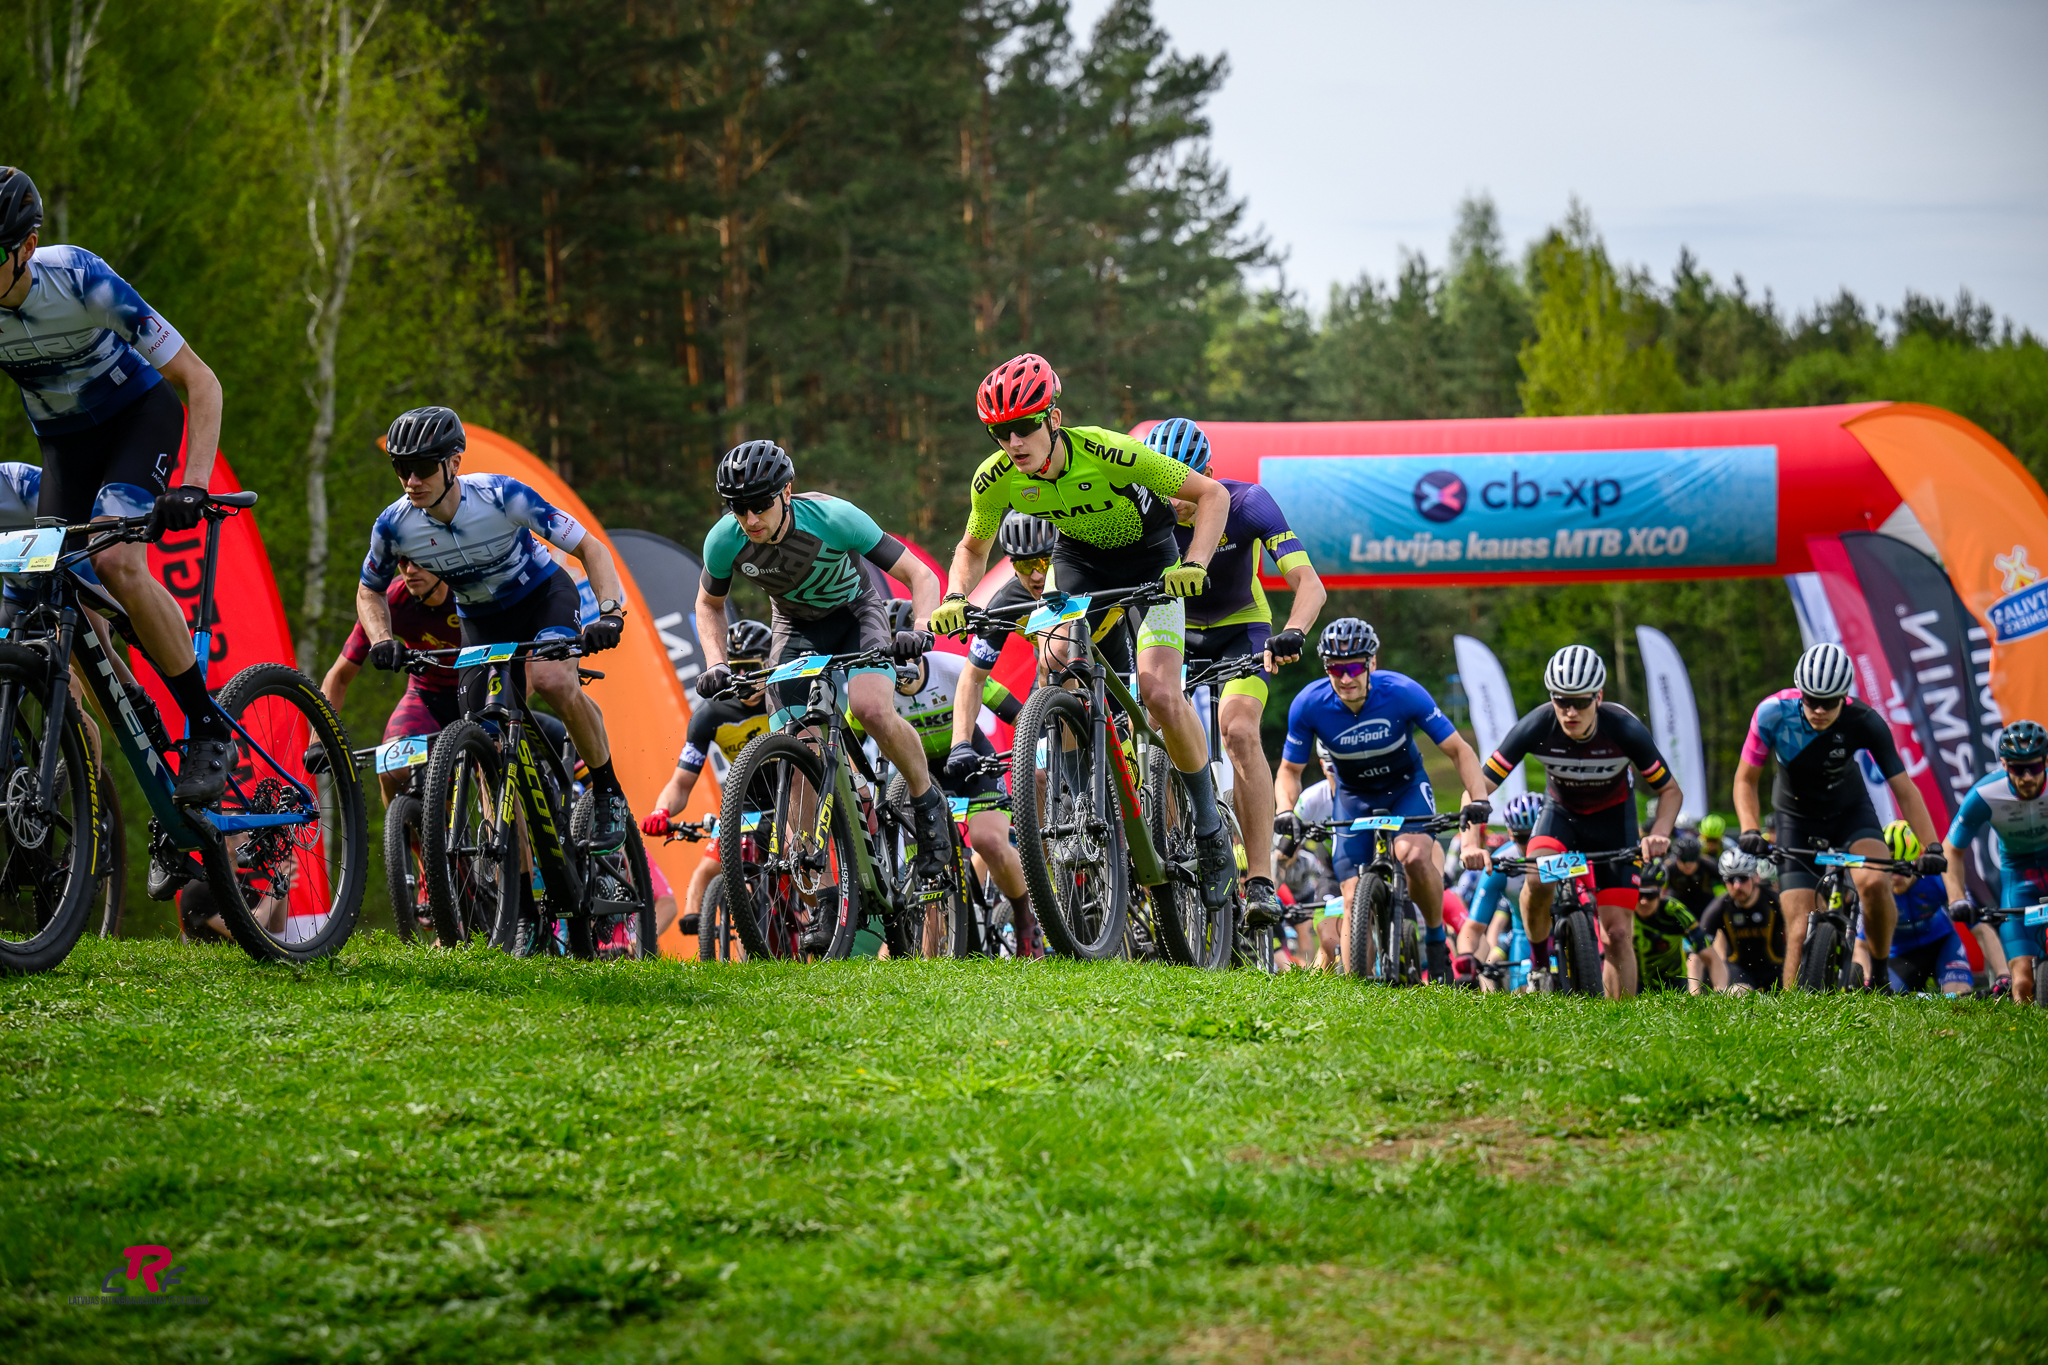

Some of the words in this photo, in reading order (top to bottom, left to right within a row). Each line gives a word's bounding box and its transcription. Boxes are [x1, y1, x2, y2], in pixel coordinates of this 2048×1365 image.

[148, 330, 170, 355] JAGUAR
[1083, 438, 1138, 468] EMU
[973, 457, 1014, 495] EMU
[1481, 471, 1622, 513] cb-xp
[1029, 500, 1113, 521] EMU
[560, 520, 577, 542] JAGUAR
[21, 534, 39, 557] 7
[1349, 531, 1462, 566] Latvijas
[1465, 530, 1550, 560] kauss
[1554, 527, 1622, 557] MTB
[1627, 525, 1689, 555] XCO
[760, 566, 781, 575] BIKE
[1142, 635, 1178, 645] EMU
[483, 646, 492, 657] 1
[791, 659, 809, 672] 2
[313, 699, 348, 749] PIRELLI
[1340, 728, 1390, 746] mySport
[388, 740, 416, 760] 34
[1547, 764, 1618, 774] TREK
[86, 760, 100, 838] PIRELLI
[519, 738, 567, 866] SCOTT
[1106, 774, 1121, 822] RENEGADE
[1543, 856, 1583, 872] 142
[919, 890, 945, 901] SCOTT
